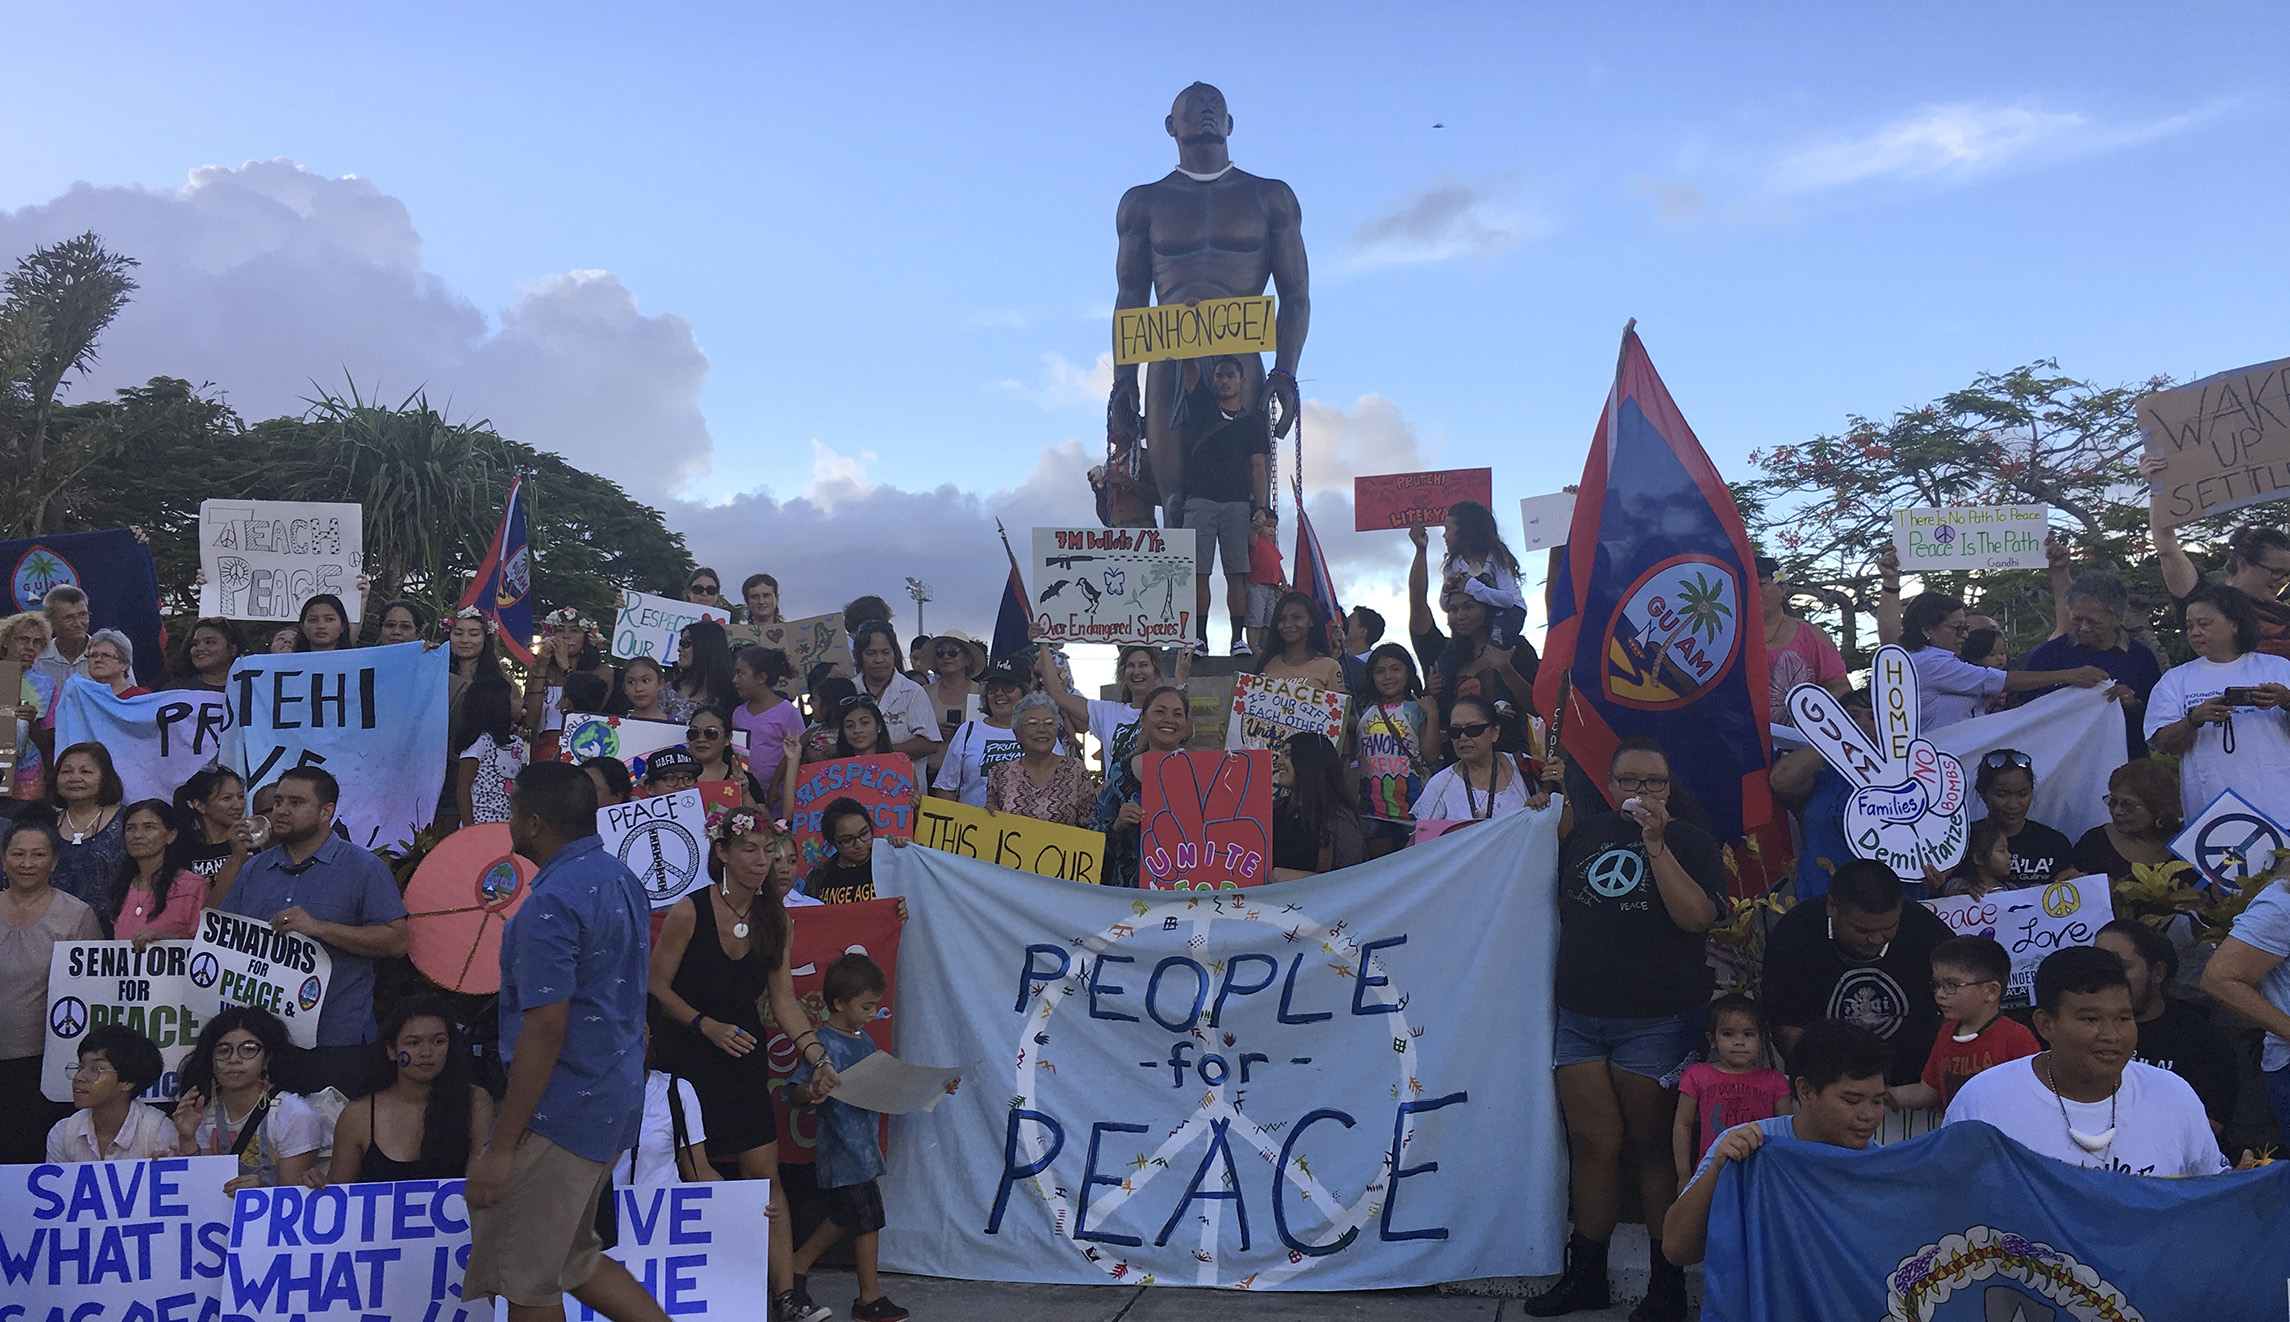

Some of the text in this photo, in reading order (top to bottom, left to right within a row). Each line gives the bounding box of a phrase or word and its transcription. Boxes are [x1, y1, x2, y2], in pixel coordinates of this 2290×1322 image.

[1120, 300, 1272, 359] FANHONGGE!
[1396, 472, 1447, 490] PRUTEHI
[2169, 461, 2290, 517] SETTL
[208, 507, 342, 555] TEACH
[1895, 507, 2042, 528] There Is No Path To Peace
[1055, 530, 1084, 550] 7M
[1908, 530, 2040, 558] Peace Is The Path
[1987, 557, 2020, 568] Gandhi
[217, 555, 343, 618] PEACE
[616, 630, 654, 657] OUR
[1069, 612, 1132, 641] Endangered
[1137, 611, 1190, 642] Species!
[1647, 596, 1714, 678] GUAM
[1248, 692, 1332, 724] IS OUR GIFT
[1250, 674, 1326, 707] PEACE
[1886, 658, 1909, 760] HOME
[1249, 705, 1325, 734] EACH OTHER
[1282, 706, 1295, 715] TO
[560, 714, 591, 748] WORLD
[1800, 696, 1881, 784] GUAM
[1913, 748, 1936, 784] NO
[795, 762, 914, 808] RESPECT
[1941, 760, 1961, 811] BOMBS
[608, 794, 679, 832] PEACE
[1858, 795, 1918, 817] Families
[923, 811, 1094, 884] THIS IS OUR
[1145, 840, 1262, 879] UNITE
[1858, 812, 1963, 872] Demilitarize
[487, 876, 514, 888] GUAM
[1619, 901, 1649, 912] PEACE
[202, 911, 317, 975] SENATORS
[2012, 917, 2093, 954] Love
[69, 946, 191, 978] SENATOR
[247, 959, 269, 978] FOR
[118, 979, 150, 1002] FOR
[219, 968, 285, 1015] PEACE
[284, 1001, 295, 1018] &
[1014, 933, 1408, 1034] PEOPLE
[27, 1158, 189, 1223] SAVE
[984, 1091, 1469, 1257] PEACE
[0, 1221, 231, 1286] WHAT IS
[227, 1247, 401, 1315] WHAT
